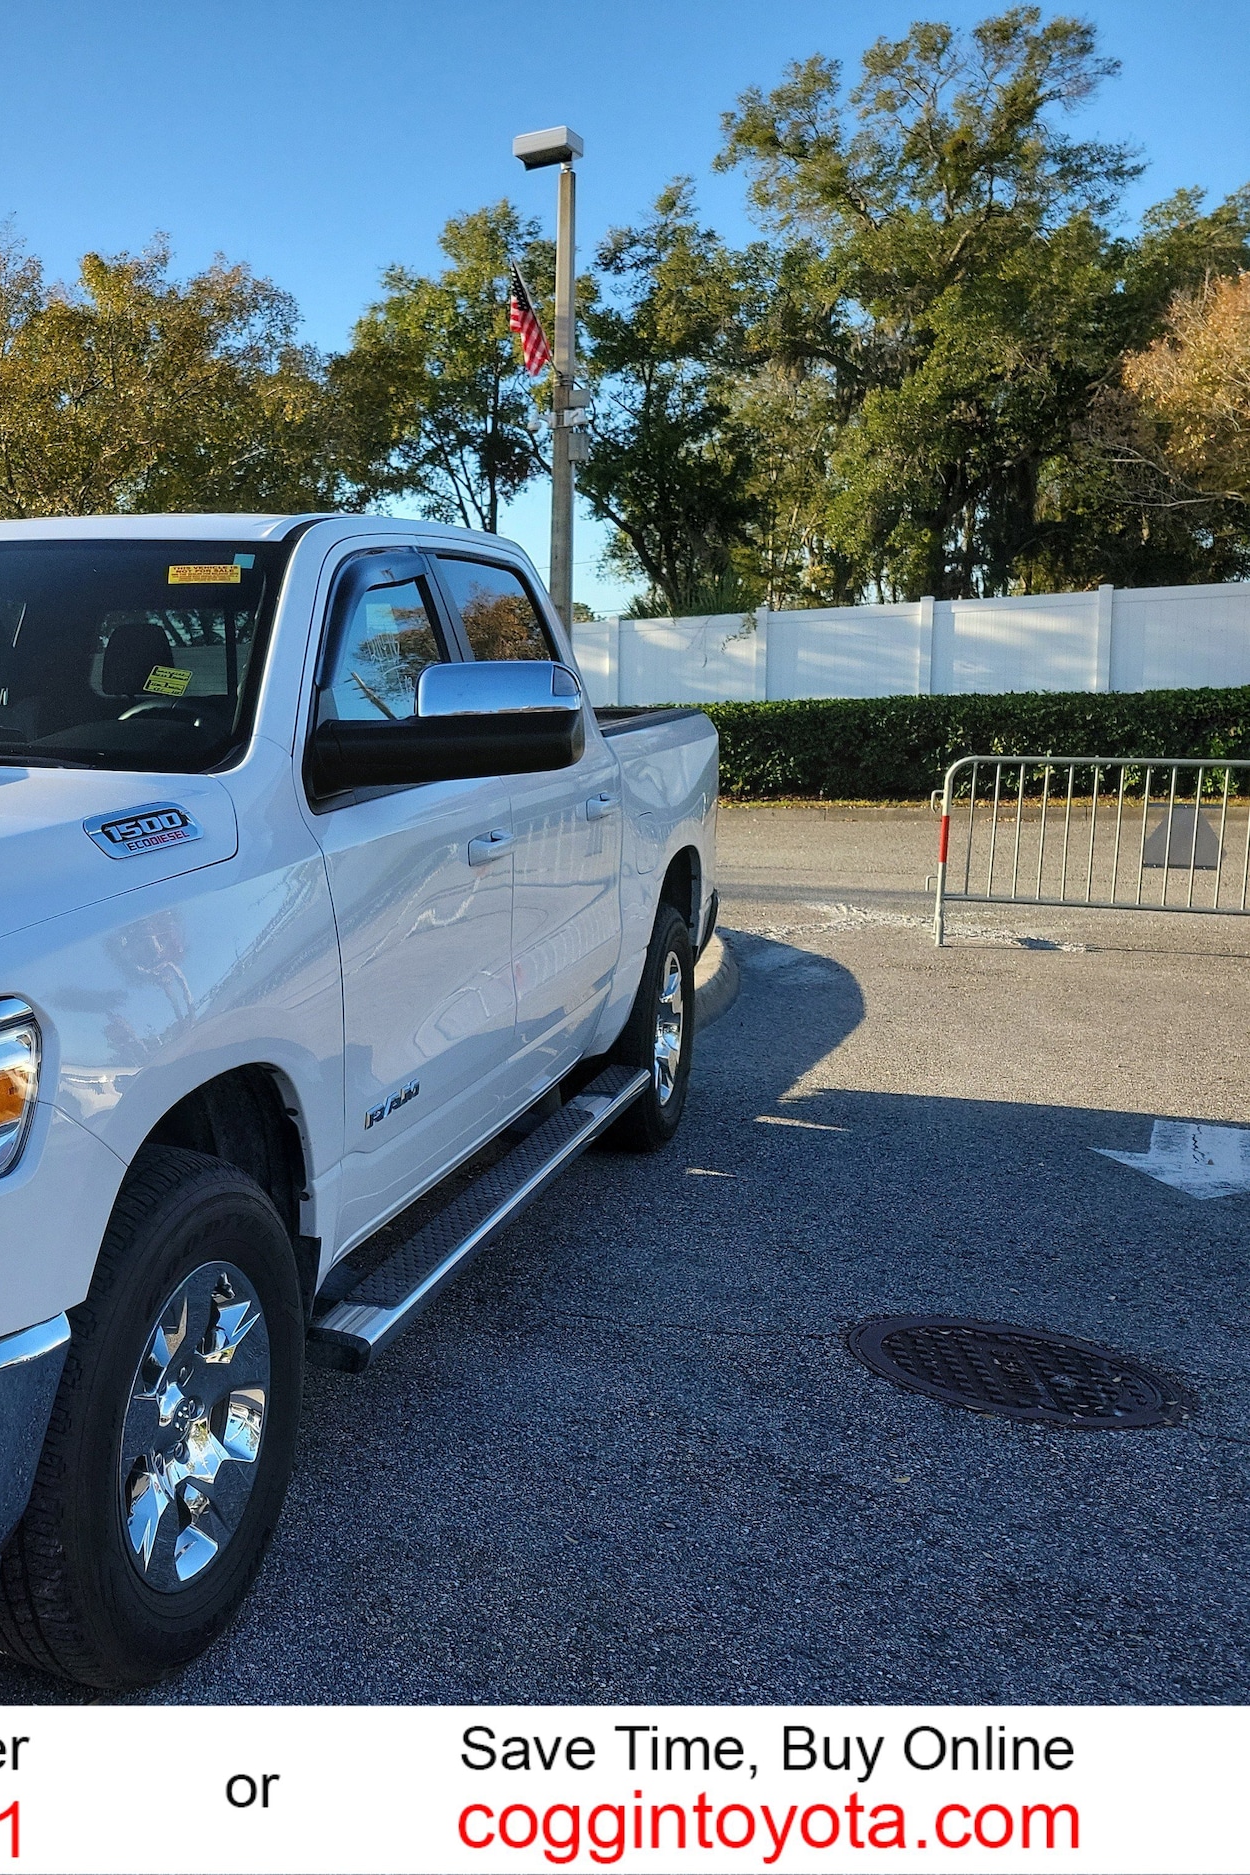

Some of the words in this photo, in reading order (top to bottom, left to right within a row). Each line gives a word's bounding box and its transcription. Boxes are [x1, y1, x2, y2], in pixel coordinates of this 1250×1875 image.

[105, 812, 183, 841] 1500
[126, 830, 190, 852] ECODIESEL
[364, 1078, 421, 1130] RAM
